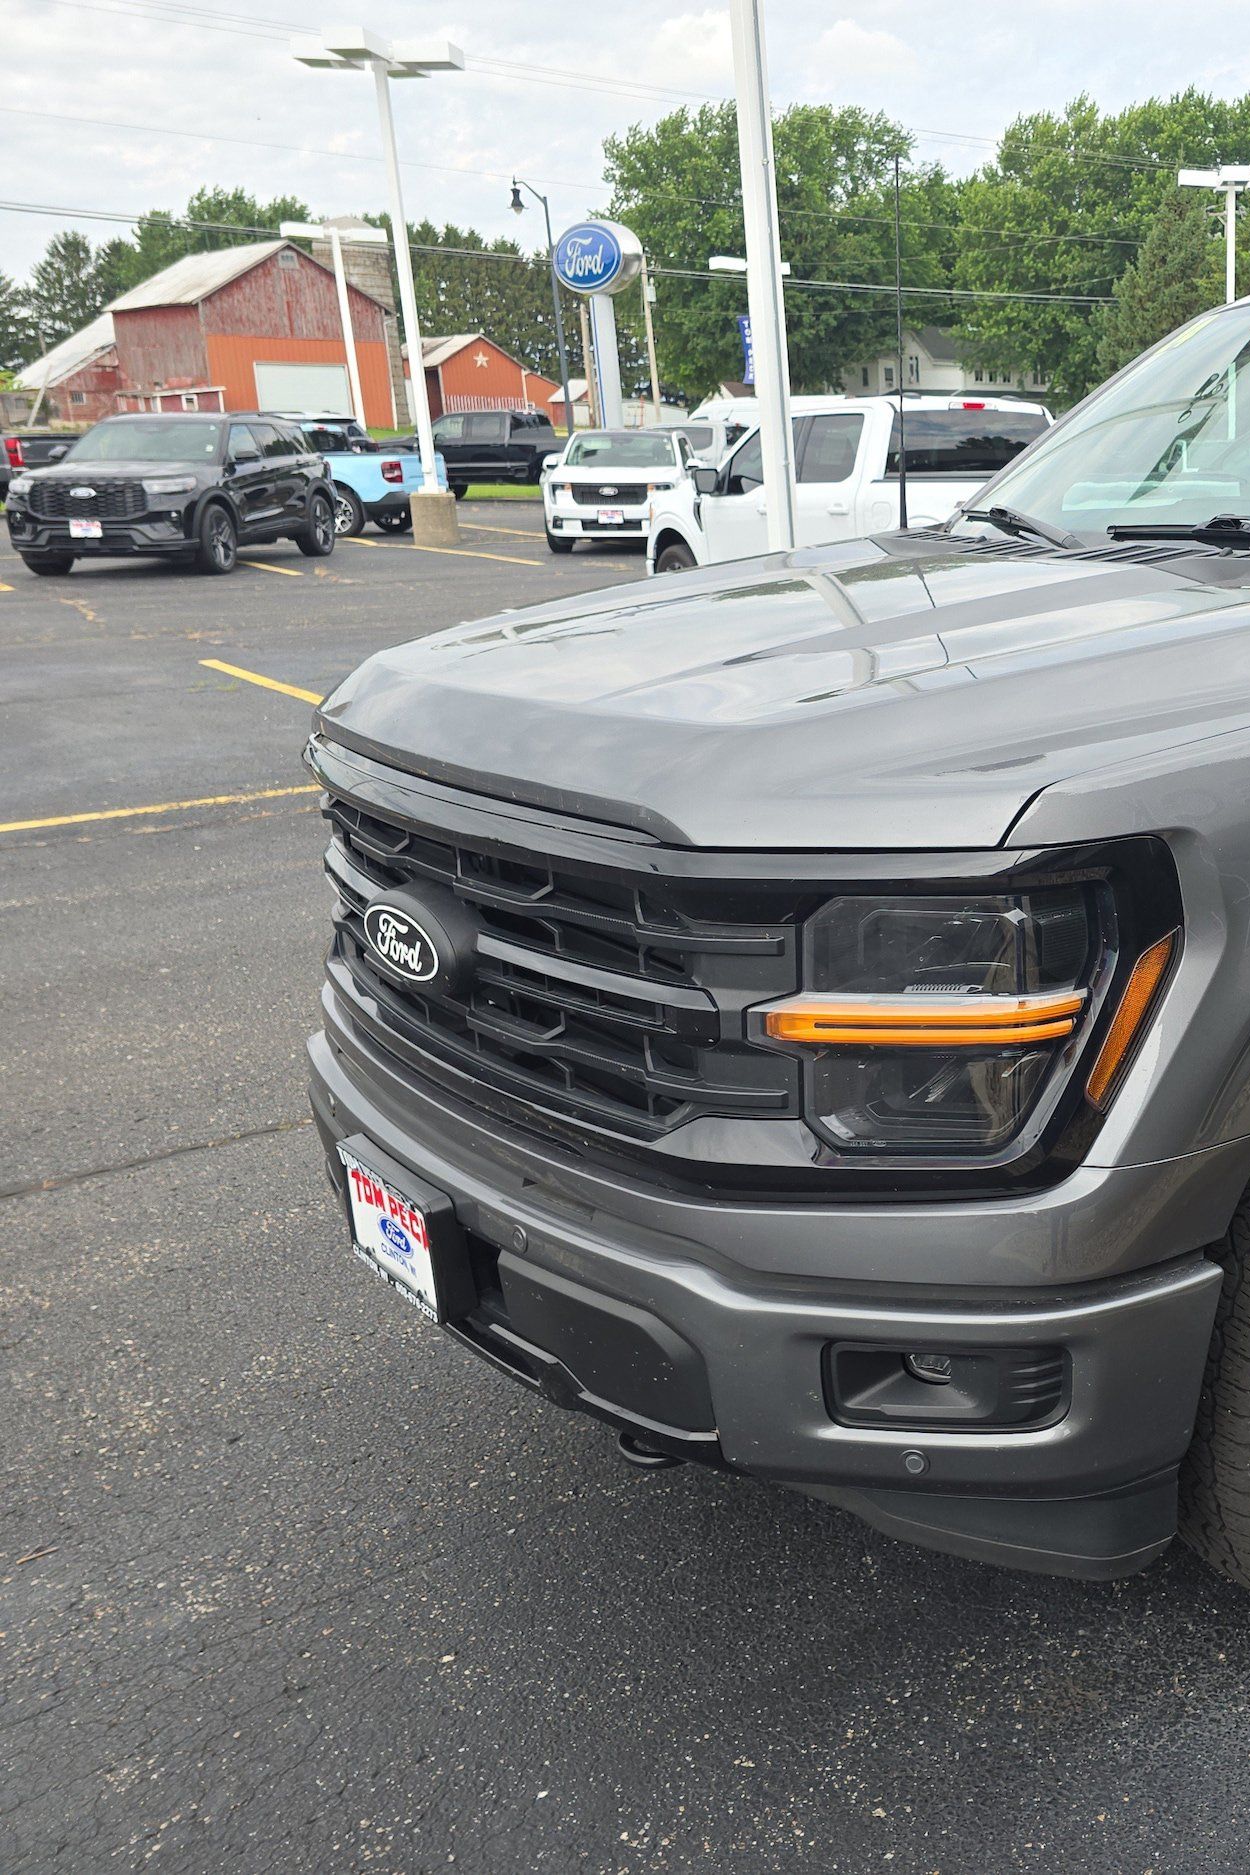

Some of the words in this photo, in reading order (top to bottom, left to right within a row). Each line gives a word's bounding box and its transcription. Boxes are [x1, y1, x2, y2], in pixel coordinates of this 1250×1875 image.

[565, 237, 604, 278] Ford
[377, 913, 422, 972] Ford
[351, 1169, 386, 1212] TOM
[385, 1220, 407, 1251] Ford
